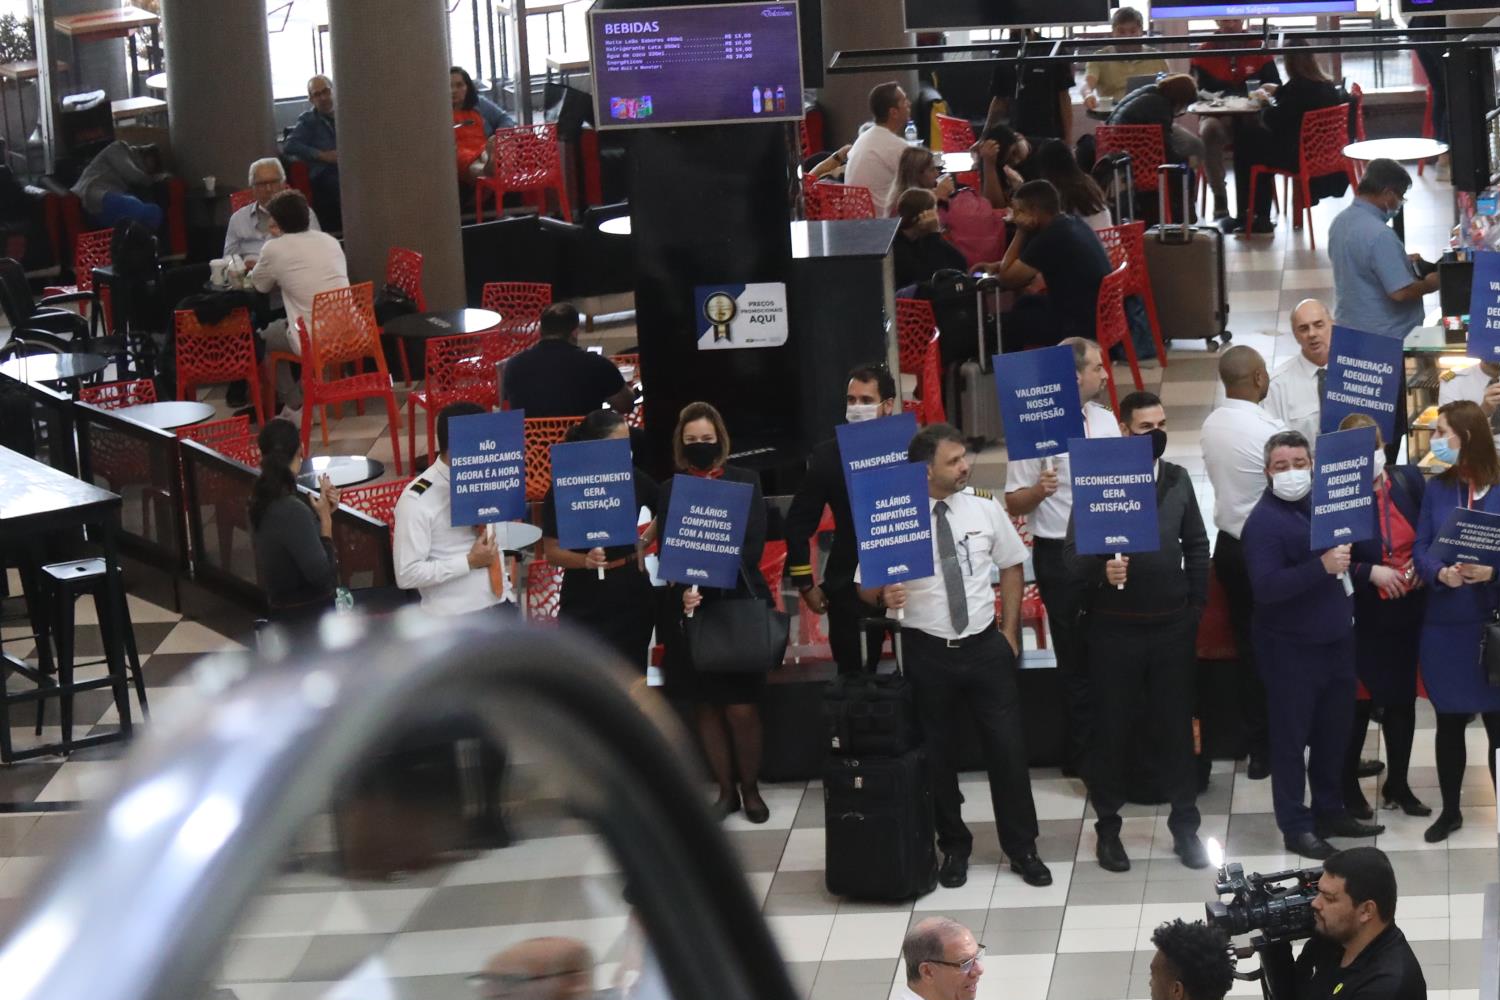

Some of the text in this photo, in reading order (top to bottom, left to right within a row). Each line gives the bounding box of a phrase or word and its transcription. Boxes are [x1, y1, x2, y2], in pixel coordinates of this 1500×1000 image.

[1246, 6, 1279, 14] Salgados
[605, 21, 659, 34] BEBIDAS
[750, 315, 775, 324] AQUI
[1486, 319, 1491, 328] À
[1337, 355, 1393, 374] REMUNERAÇÃO
[1343, 370, 1383, 385] ADEQUADA
[1015, 384, 1061, 398] VALORIZEM
[1343, 382, 1380, 397] TAMBÉM É
[1027, 398, 1054, 409] NOSSA
[1327, 391, 1394, 412] RECONHECIMENTO
[1019, 408, 1065, 423] PROFISSÃO
[480, 440, 496, 450] NÃO
[849, 451, 908, 470] TRANSPARÊNC
[1321, 456, 1368, 473] REMUNERAÇÃO
[457, 466, 519, 481] AGORA É A HORA
[557, 472, 630, 487] RECONHECIMENTO
[1075, 474, 1151, 486] RECONHECIMENTO
[1327, 472, 1360, 486] ADEQUADA
[457, 478, 519, 493] DA RETRIBUIÇÃO
[584, 487, 606, 497] GERA
[1328, 484, 1359, 499] TAMBÉM É
[1103, 489, 1126, 498] GERA
[571, 497, 620, 510] SATISFAÇÃO
[876, 495, 910, 509] SALÁRIOS
[1090, 500, 1140, 513] SATISFAÇÃO
[1315, 496, 1371, 515] RECONHECIMENTO
[690, 505, 727, 518] SALÁRIOS
[871, 507, 917, 523] COMPATÍVEIS
[682, 517, 732, 530] COMPATÍVEIS
[871, 520, 919, 536] COM A NOSSA
[679, 528, 696, 537] COM
[704, 532, 730, 542] NOSSA
[861, 530, 930, 550] RESPONSABILIDADE
[666, 537, 740, 554] RESPONSABILIDADE
